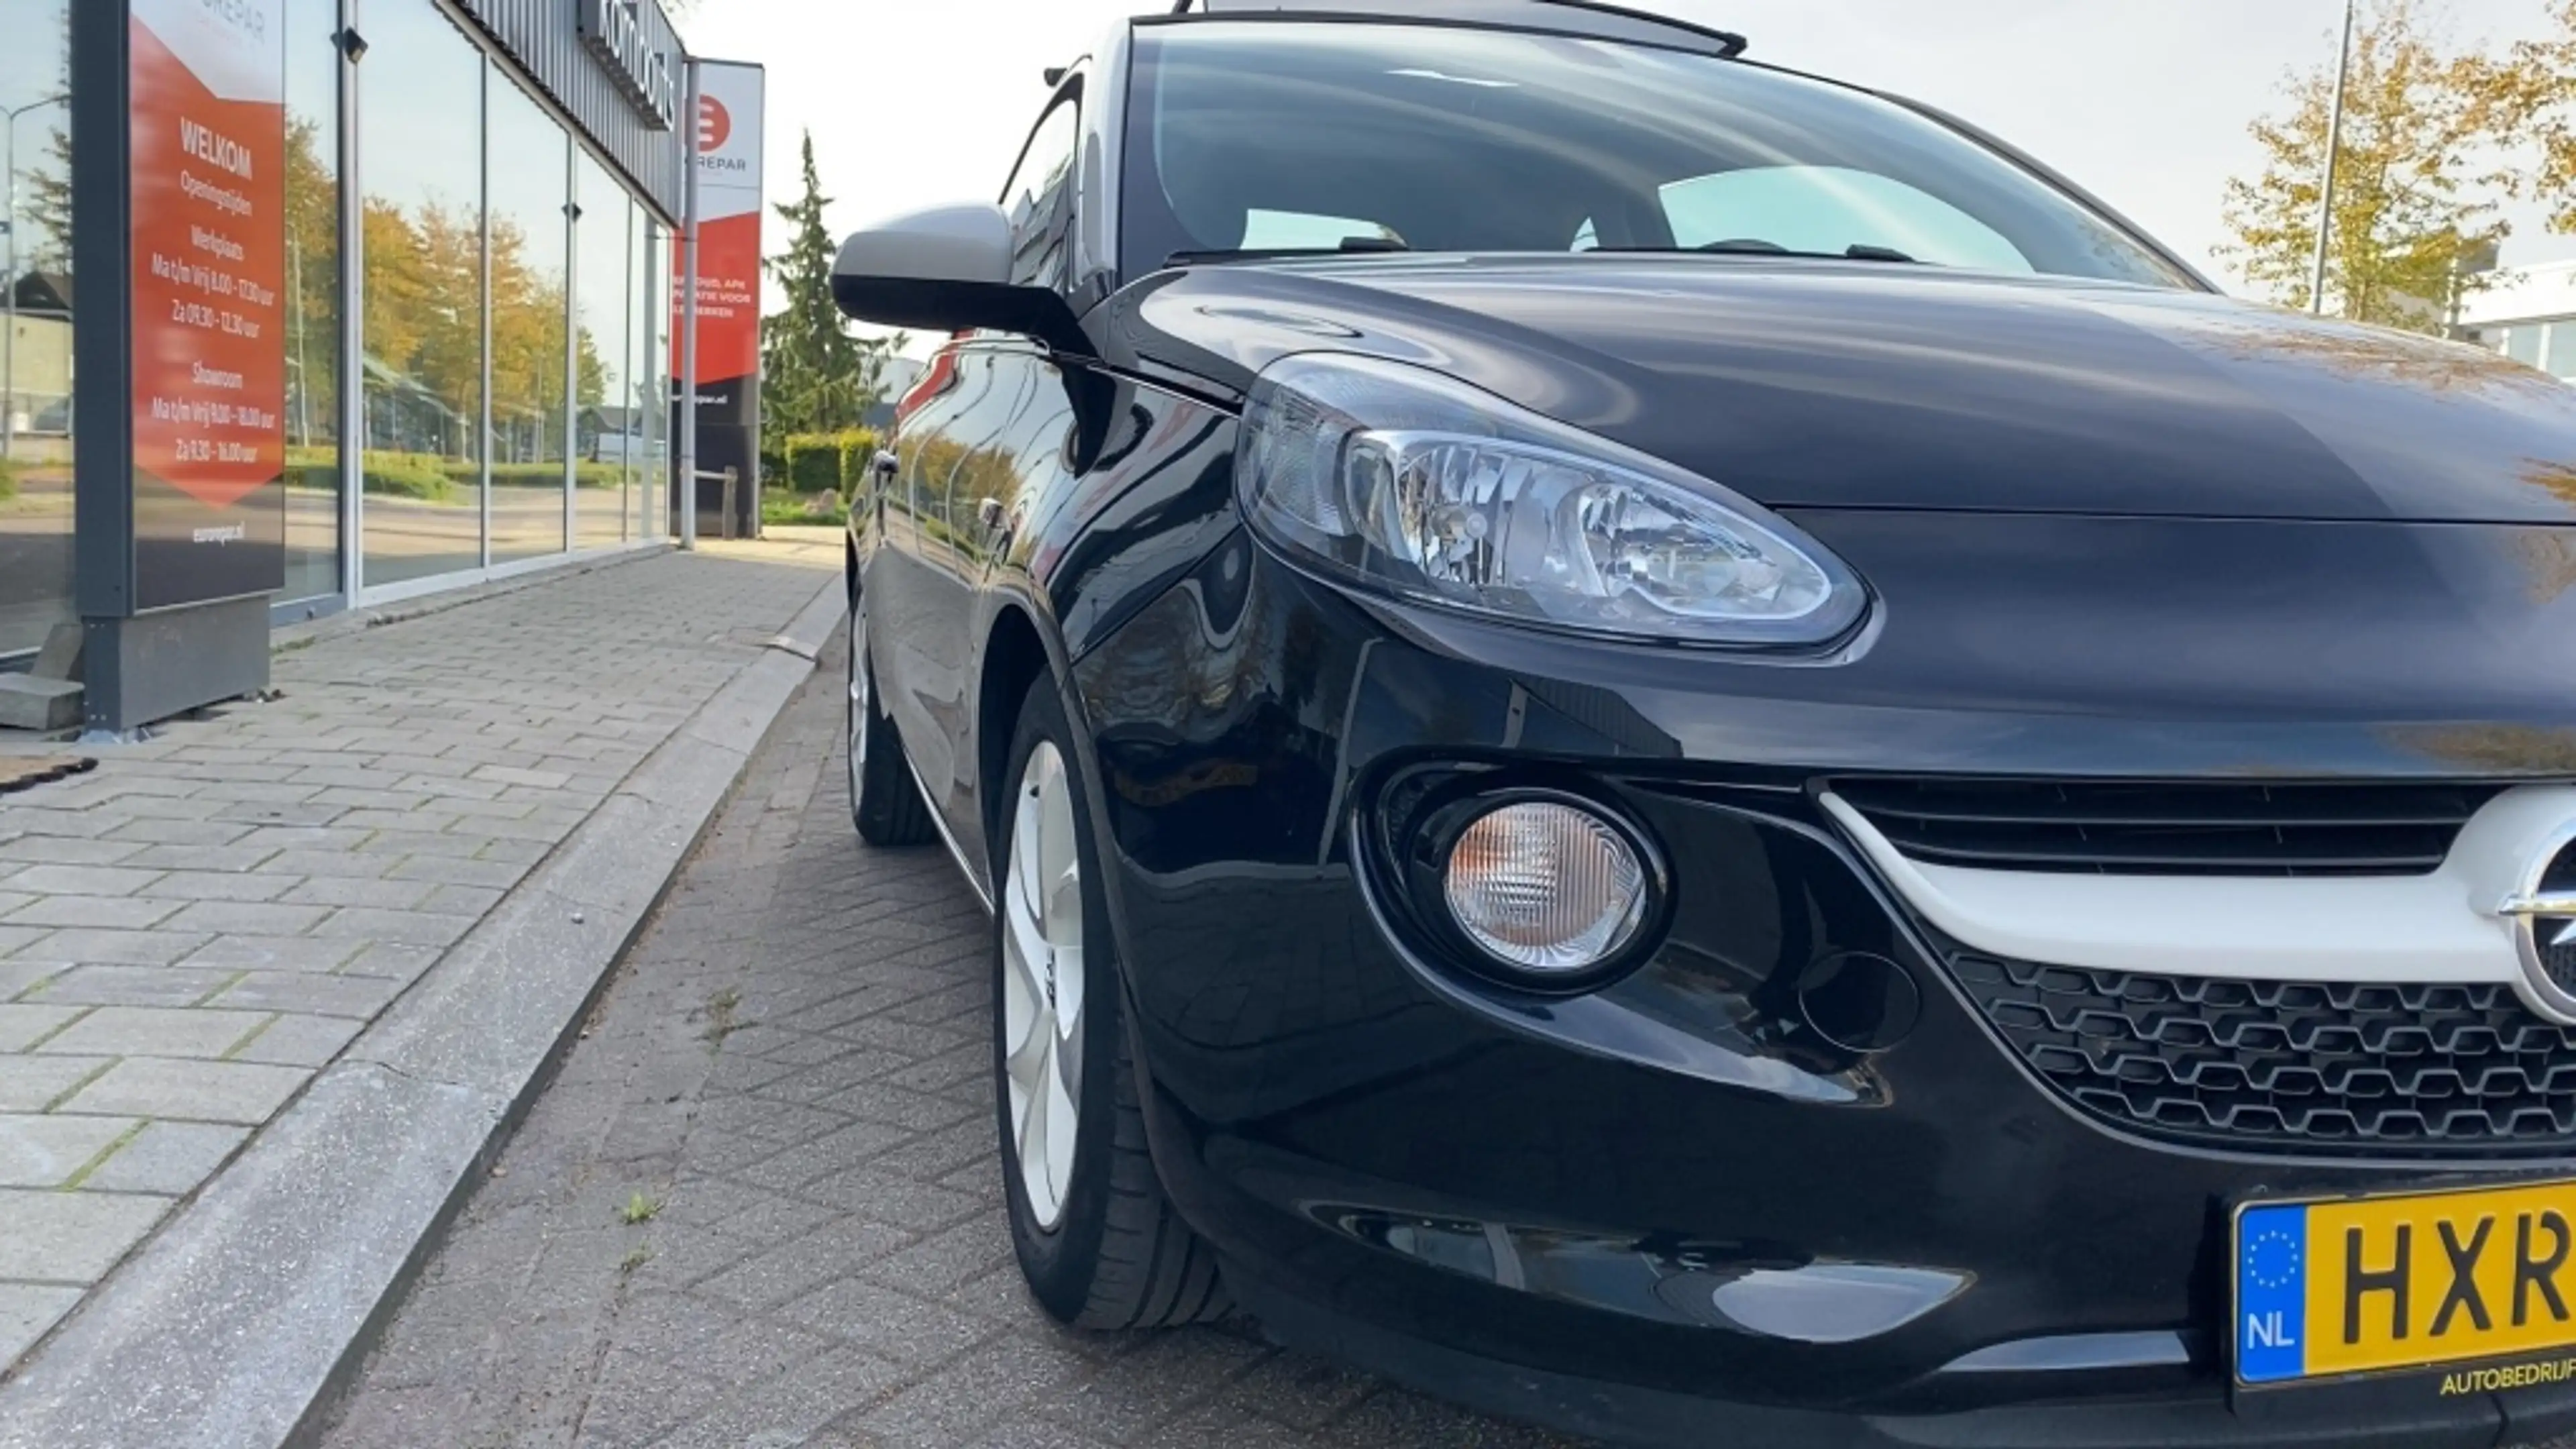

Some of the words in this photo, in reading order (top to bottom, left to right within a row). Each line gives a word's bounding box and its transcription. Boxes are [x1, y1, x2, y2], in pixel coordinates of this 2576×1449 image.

[180, 115, 252, 181] WELKOM
[696, 155, 746, 171] REPAR
[180, 169, 253, 216] Openingstijden
[191, 224, 244, 261] Werkplaats
[152, 252, 169, 278] Ma
[172, 299, 185, 323] Za
[193, 360, 243, 389] Showroom
[152, 396, 169, 419] Ma
[175, 438, 189, 462] Za
[2344, 1210, 2571, 1345] HXR
[2247, 1310, 2296, 1350] NL
[2439, 1358, 2576, 1396] AUTOBEDRIJF
